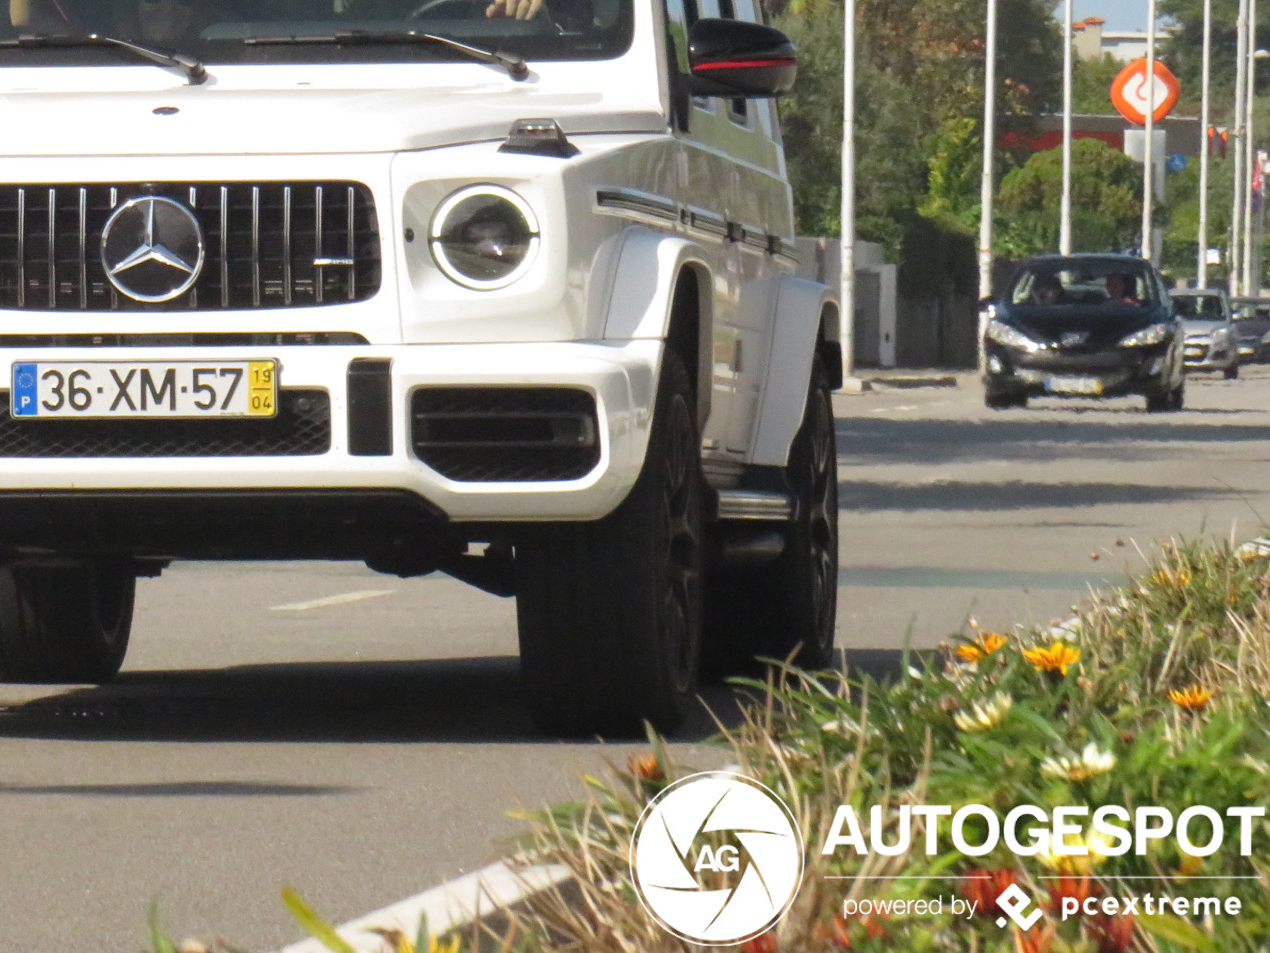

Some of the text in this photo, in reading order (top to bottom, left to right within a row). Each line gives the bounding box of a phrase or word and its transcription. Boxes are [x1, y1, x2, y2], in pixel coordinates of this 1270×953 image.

[253, 369, 272, 383] 19
[21, 396, 31, 408] P
[251, 395, 272, 409] 04
